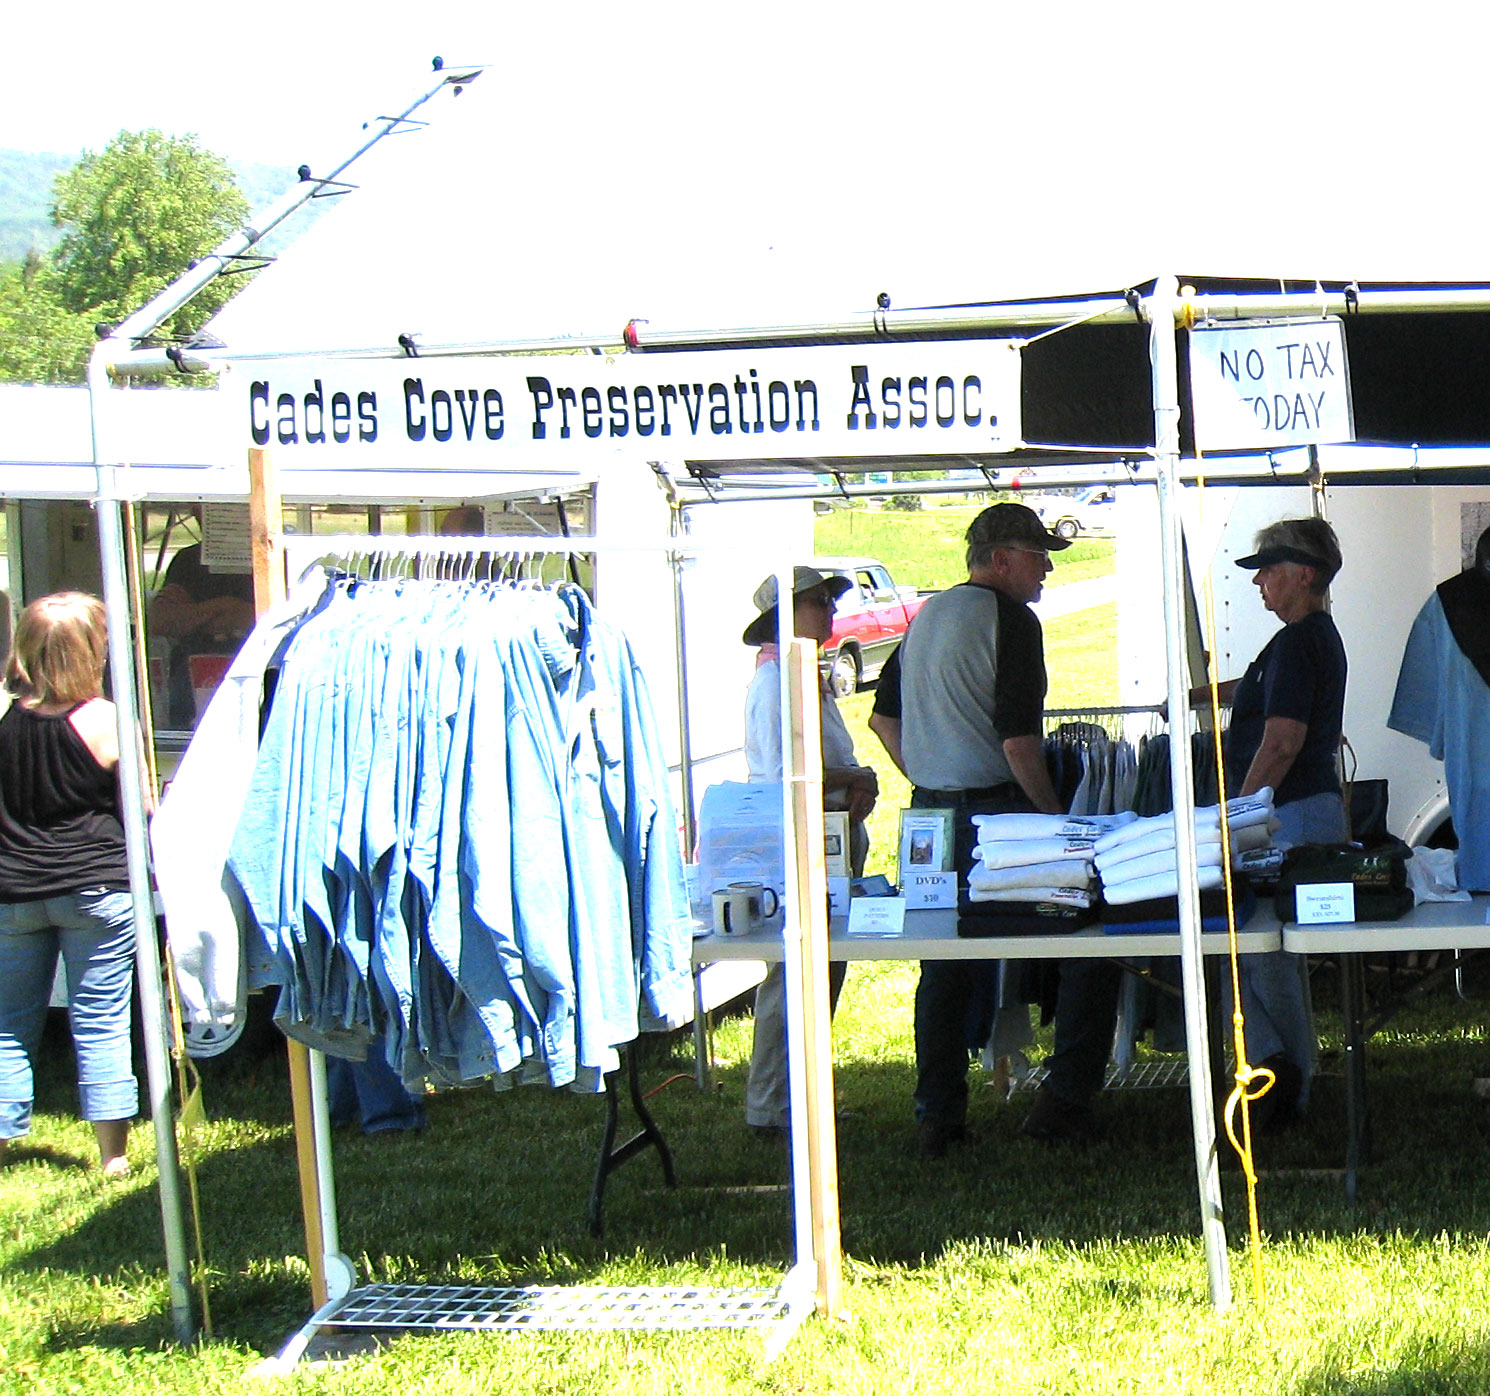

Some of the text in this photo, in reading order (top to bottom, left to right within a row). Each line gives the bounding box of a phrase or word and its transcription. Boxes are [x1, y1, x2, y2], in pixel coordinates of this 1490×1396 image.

[1220, 341, 1334, 382] NO TAX
[250, 365, 998, 445] Cades Cove Preservation Assoc.
[1239, 391, 1325, 431] ODAY
[915, 877, 947, 886] DVD's
